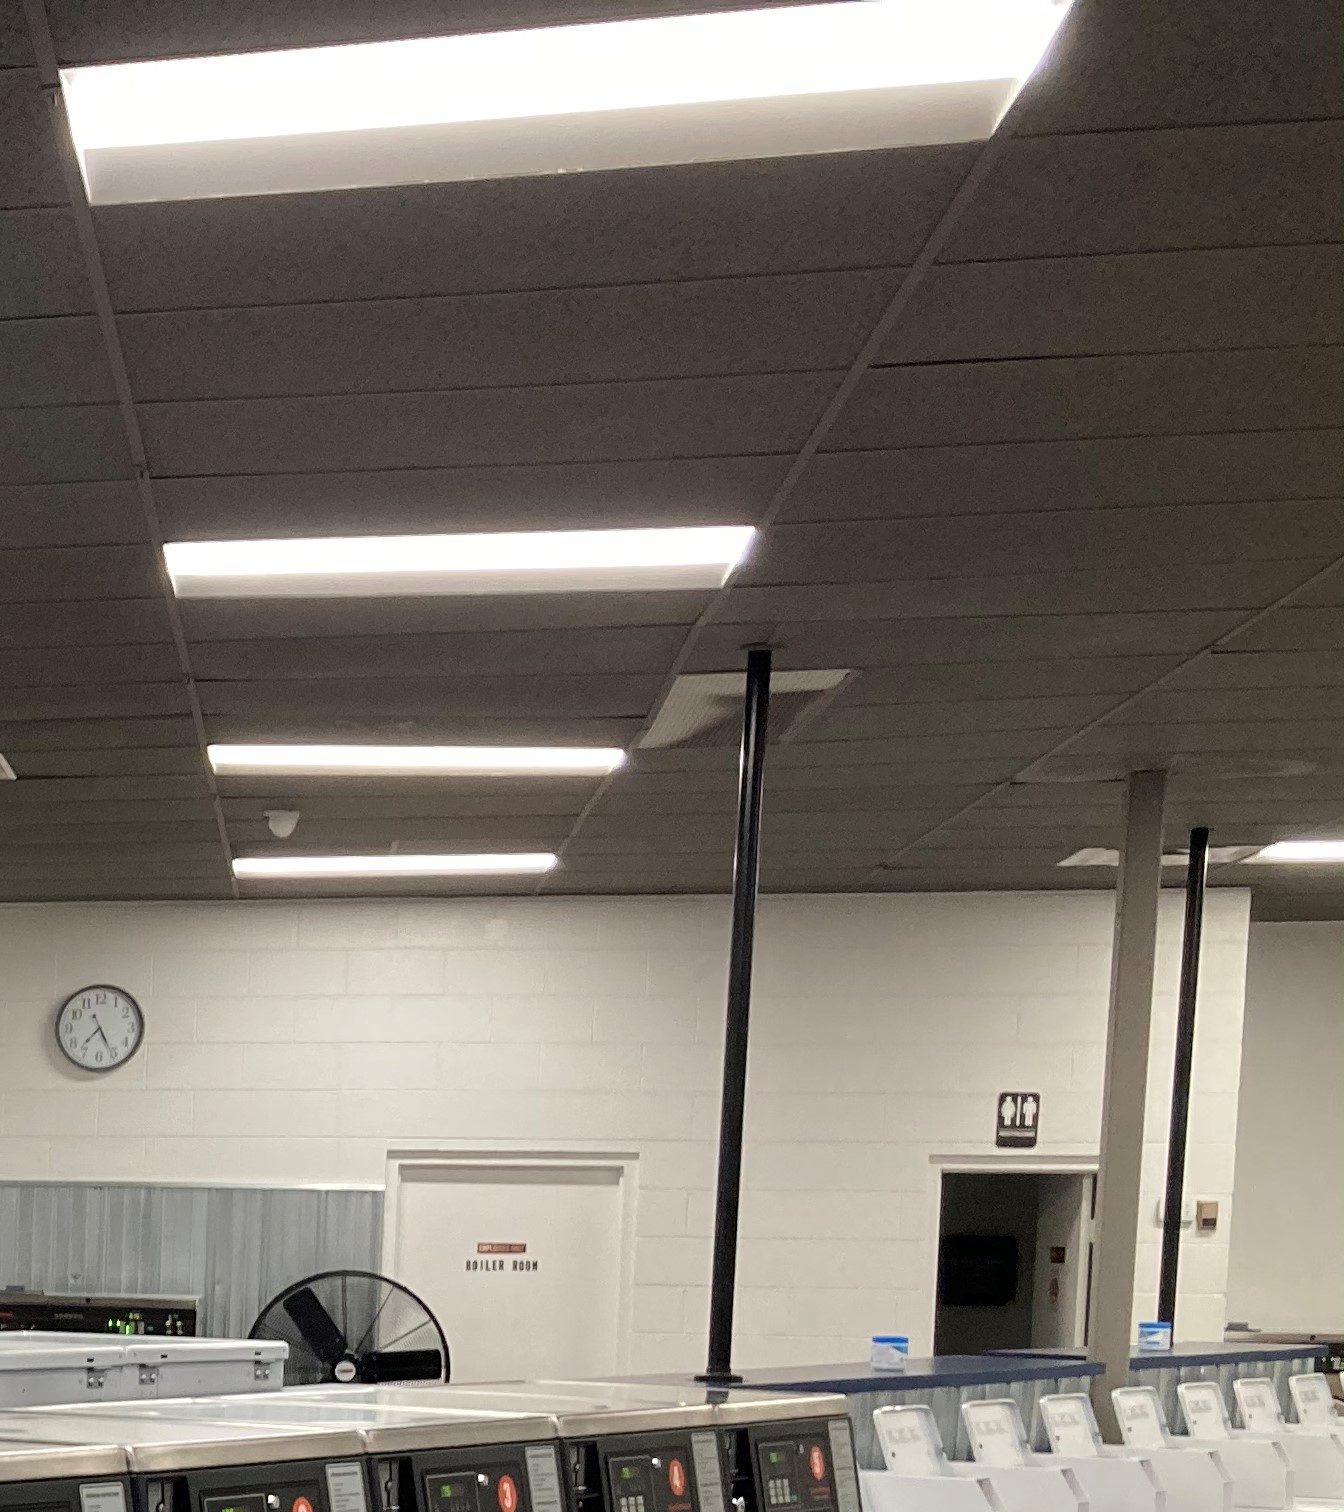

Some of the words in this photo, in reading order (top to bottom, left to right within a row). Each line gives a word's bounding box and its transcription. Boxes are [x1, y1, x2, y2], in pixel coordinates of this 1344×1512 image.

[466, 1260, 505, 1271] BOILER
[512, 1260, 538, 1271] ROOM
[503, 1482, 512, 1508] 3
